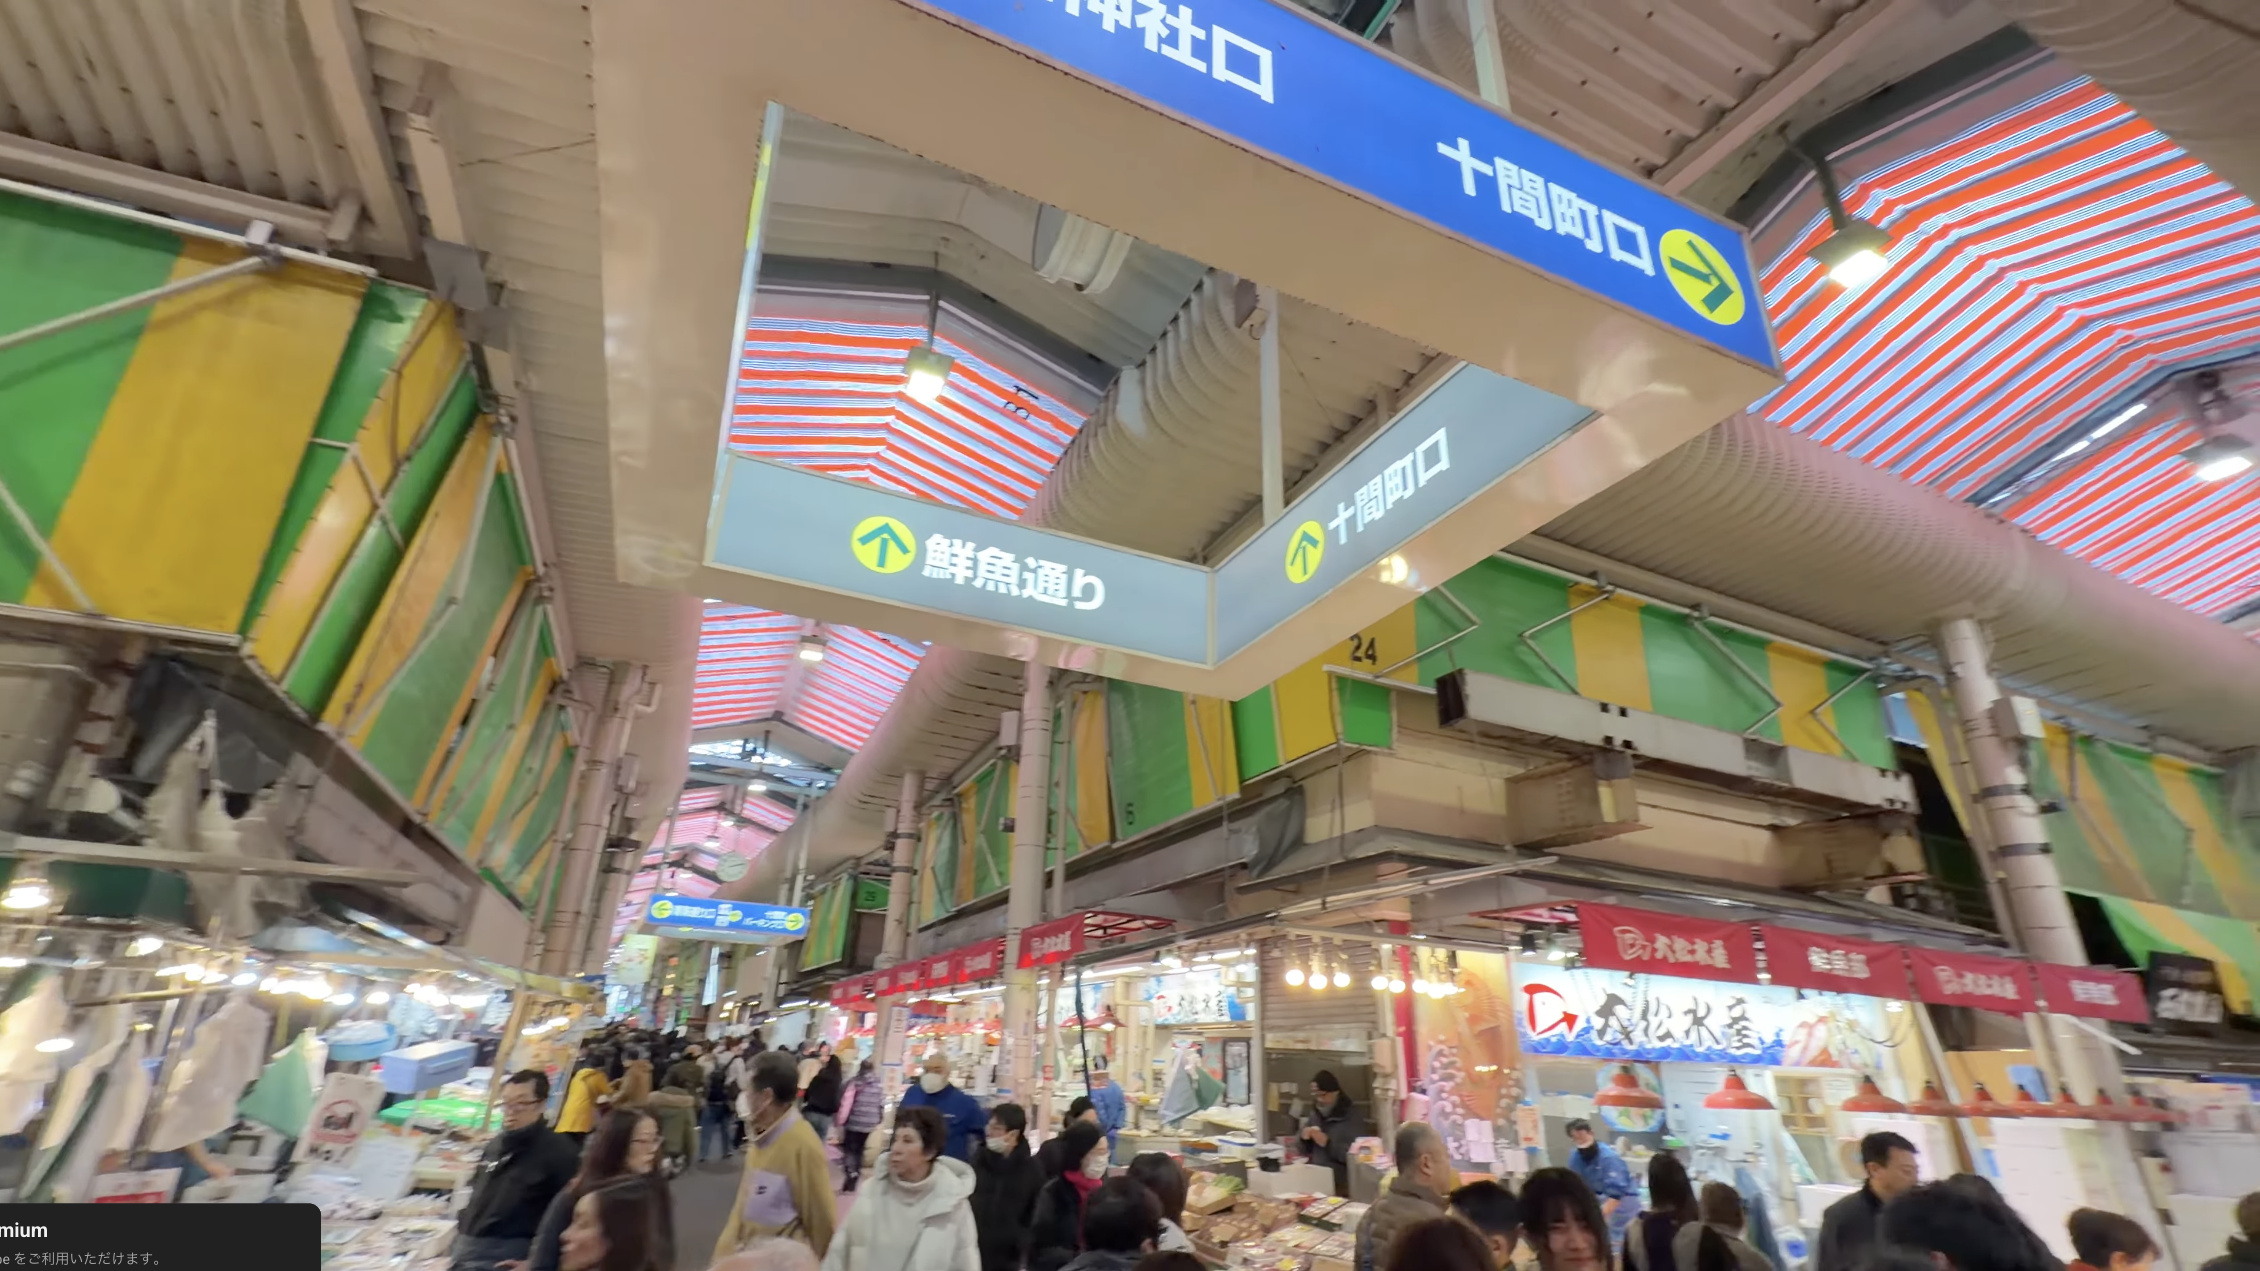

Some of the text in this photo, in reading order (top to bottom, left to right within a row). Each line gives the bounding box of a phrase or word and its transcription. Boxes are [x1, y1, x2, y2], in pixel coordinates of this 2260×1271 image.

[1436, 137, 1656, 276] 十間町口
[1327, 426, 1451, 545] 十間町口
[921, 533, 1106, 610] 鮮魚通り
[1349, 632, 1377, 666] 24
